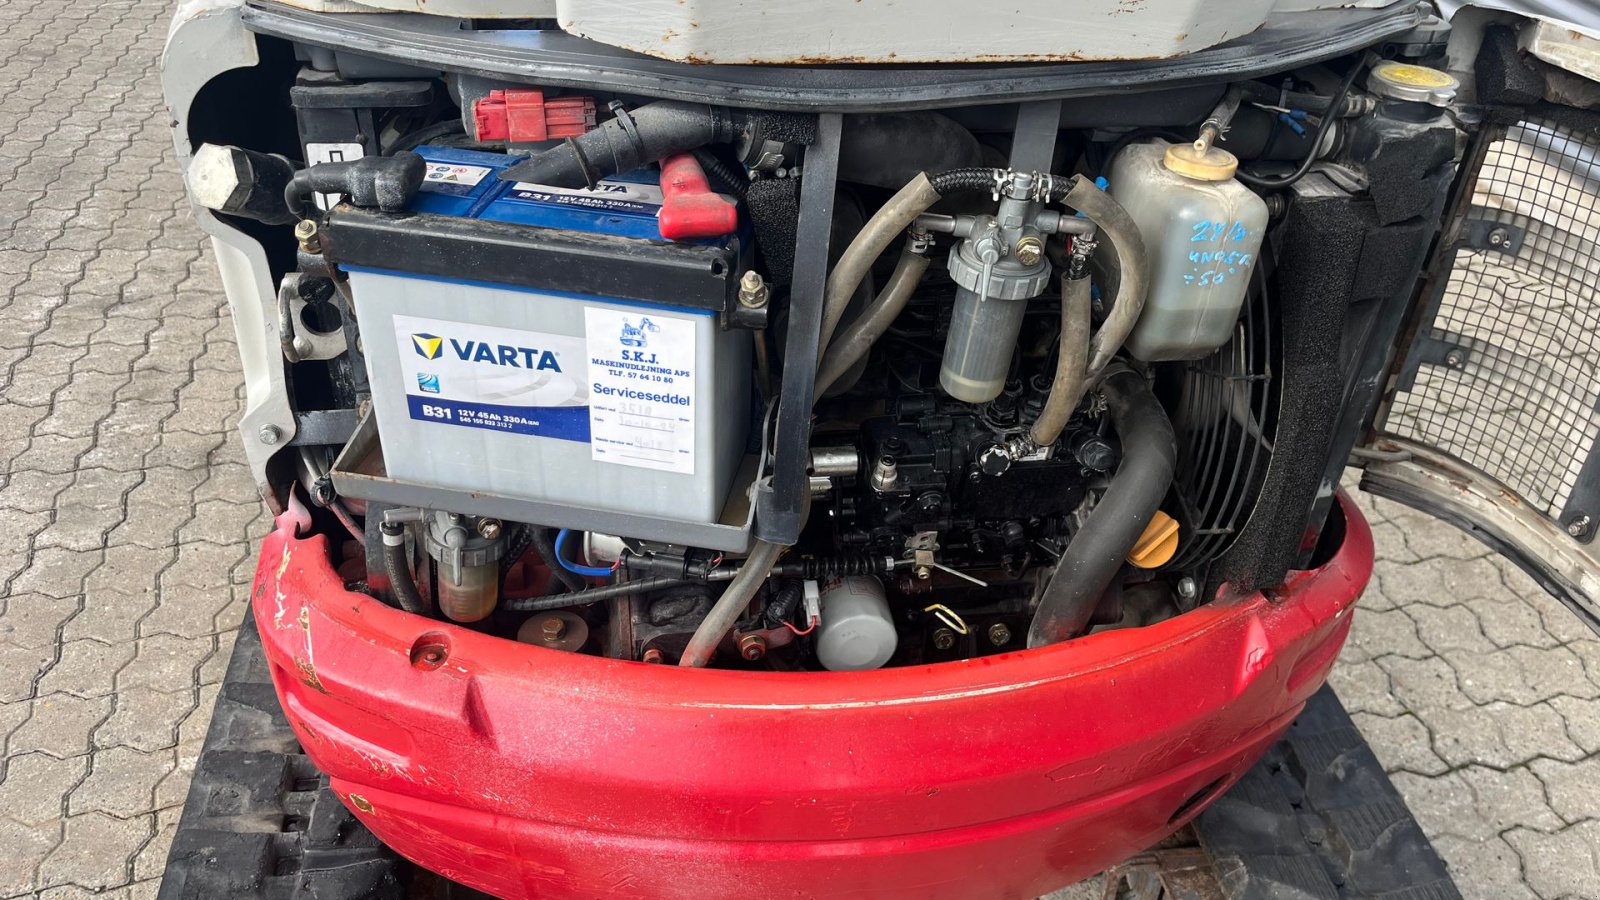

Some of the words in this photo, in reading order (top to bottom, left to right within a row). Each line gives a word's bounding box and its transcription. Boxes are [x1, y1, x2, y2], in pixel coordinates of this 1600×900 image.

[518, 191, 551, 201] B31
[449, 338, 563, 373] VARTA
[621, 349, 660, 365] S.K.J.
[591, 358, 672, 375] MASKINUDLEJNING
[674, 369, 690, 378] APS
[608, 369, 626, 378] TLF.
[639, 373, 650, 381] 64
[663, 376, 674, 384] 80
[593, 382, 690, 406] Serviceseddel
[422, 404, 452, 420] B31
[458, 409, 476, 418] 12V
[477, 411, 501, 421] 45Ah
